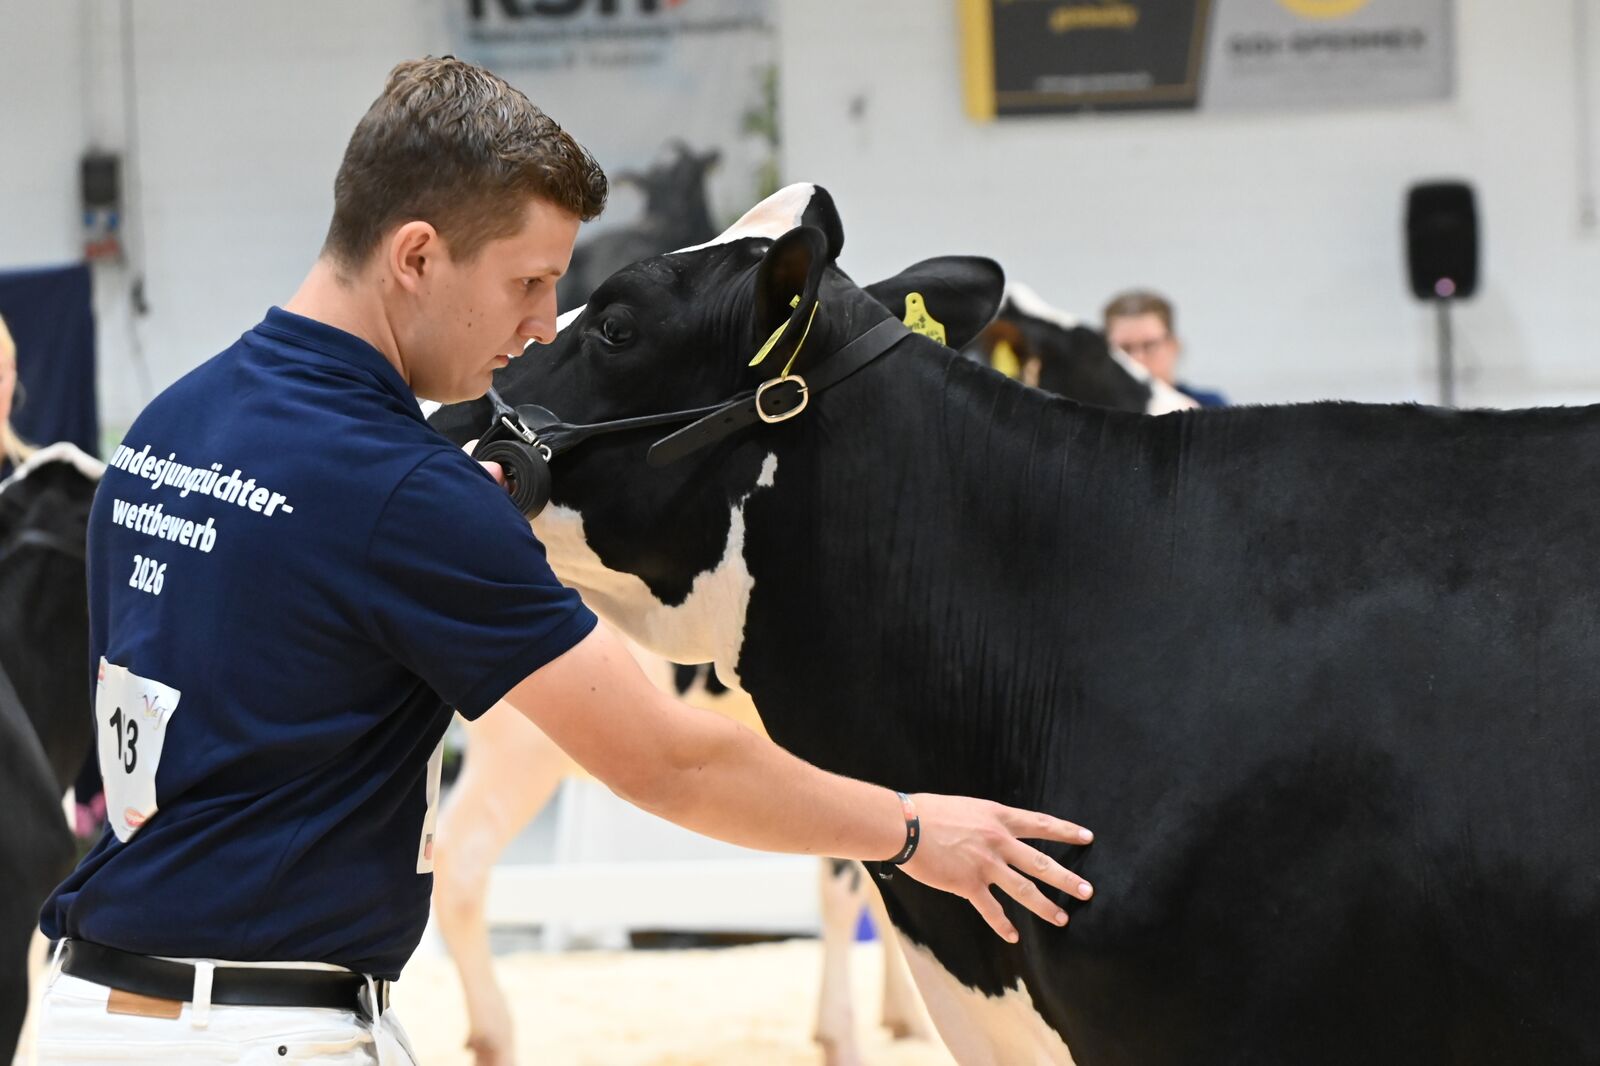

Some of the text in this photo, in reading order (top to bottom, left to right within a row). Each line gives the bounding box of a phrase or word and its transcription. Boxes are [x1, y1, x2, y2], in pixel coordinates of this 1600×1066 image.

[112, 498, 217, 553] wettbewerb
[129, 555, 167, 595] 2026
[109, 706, 139, 774] 13
